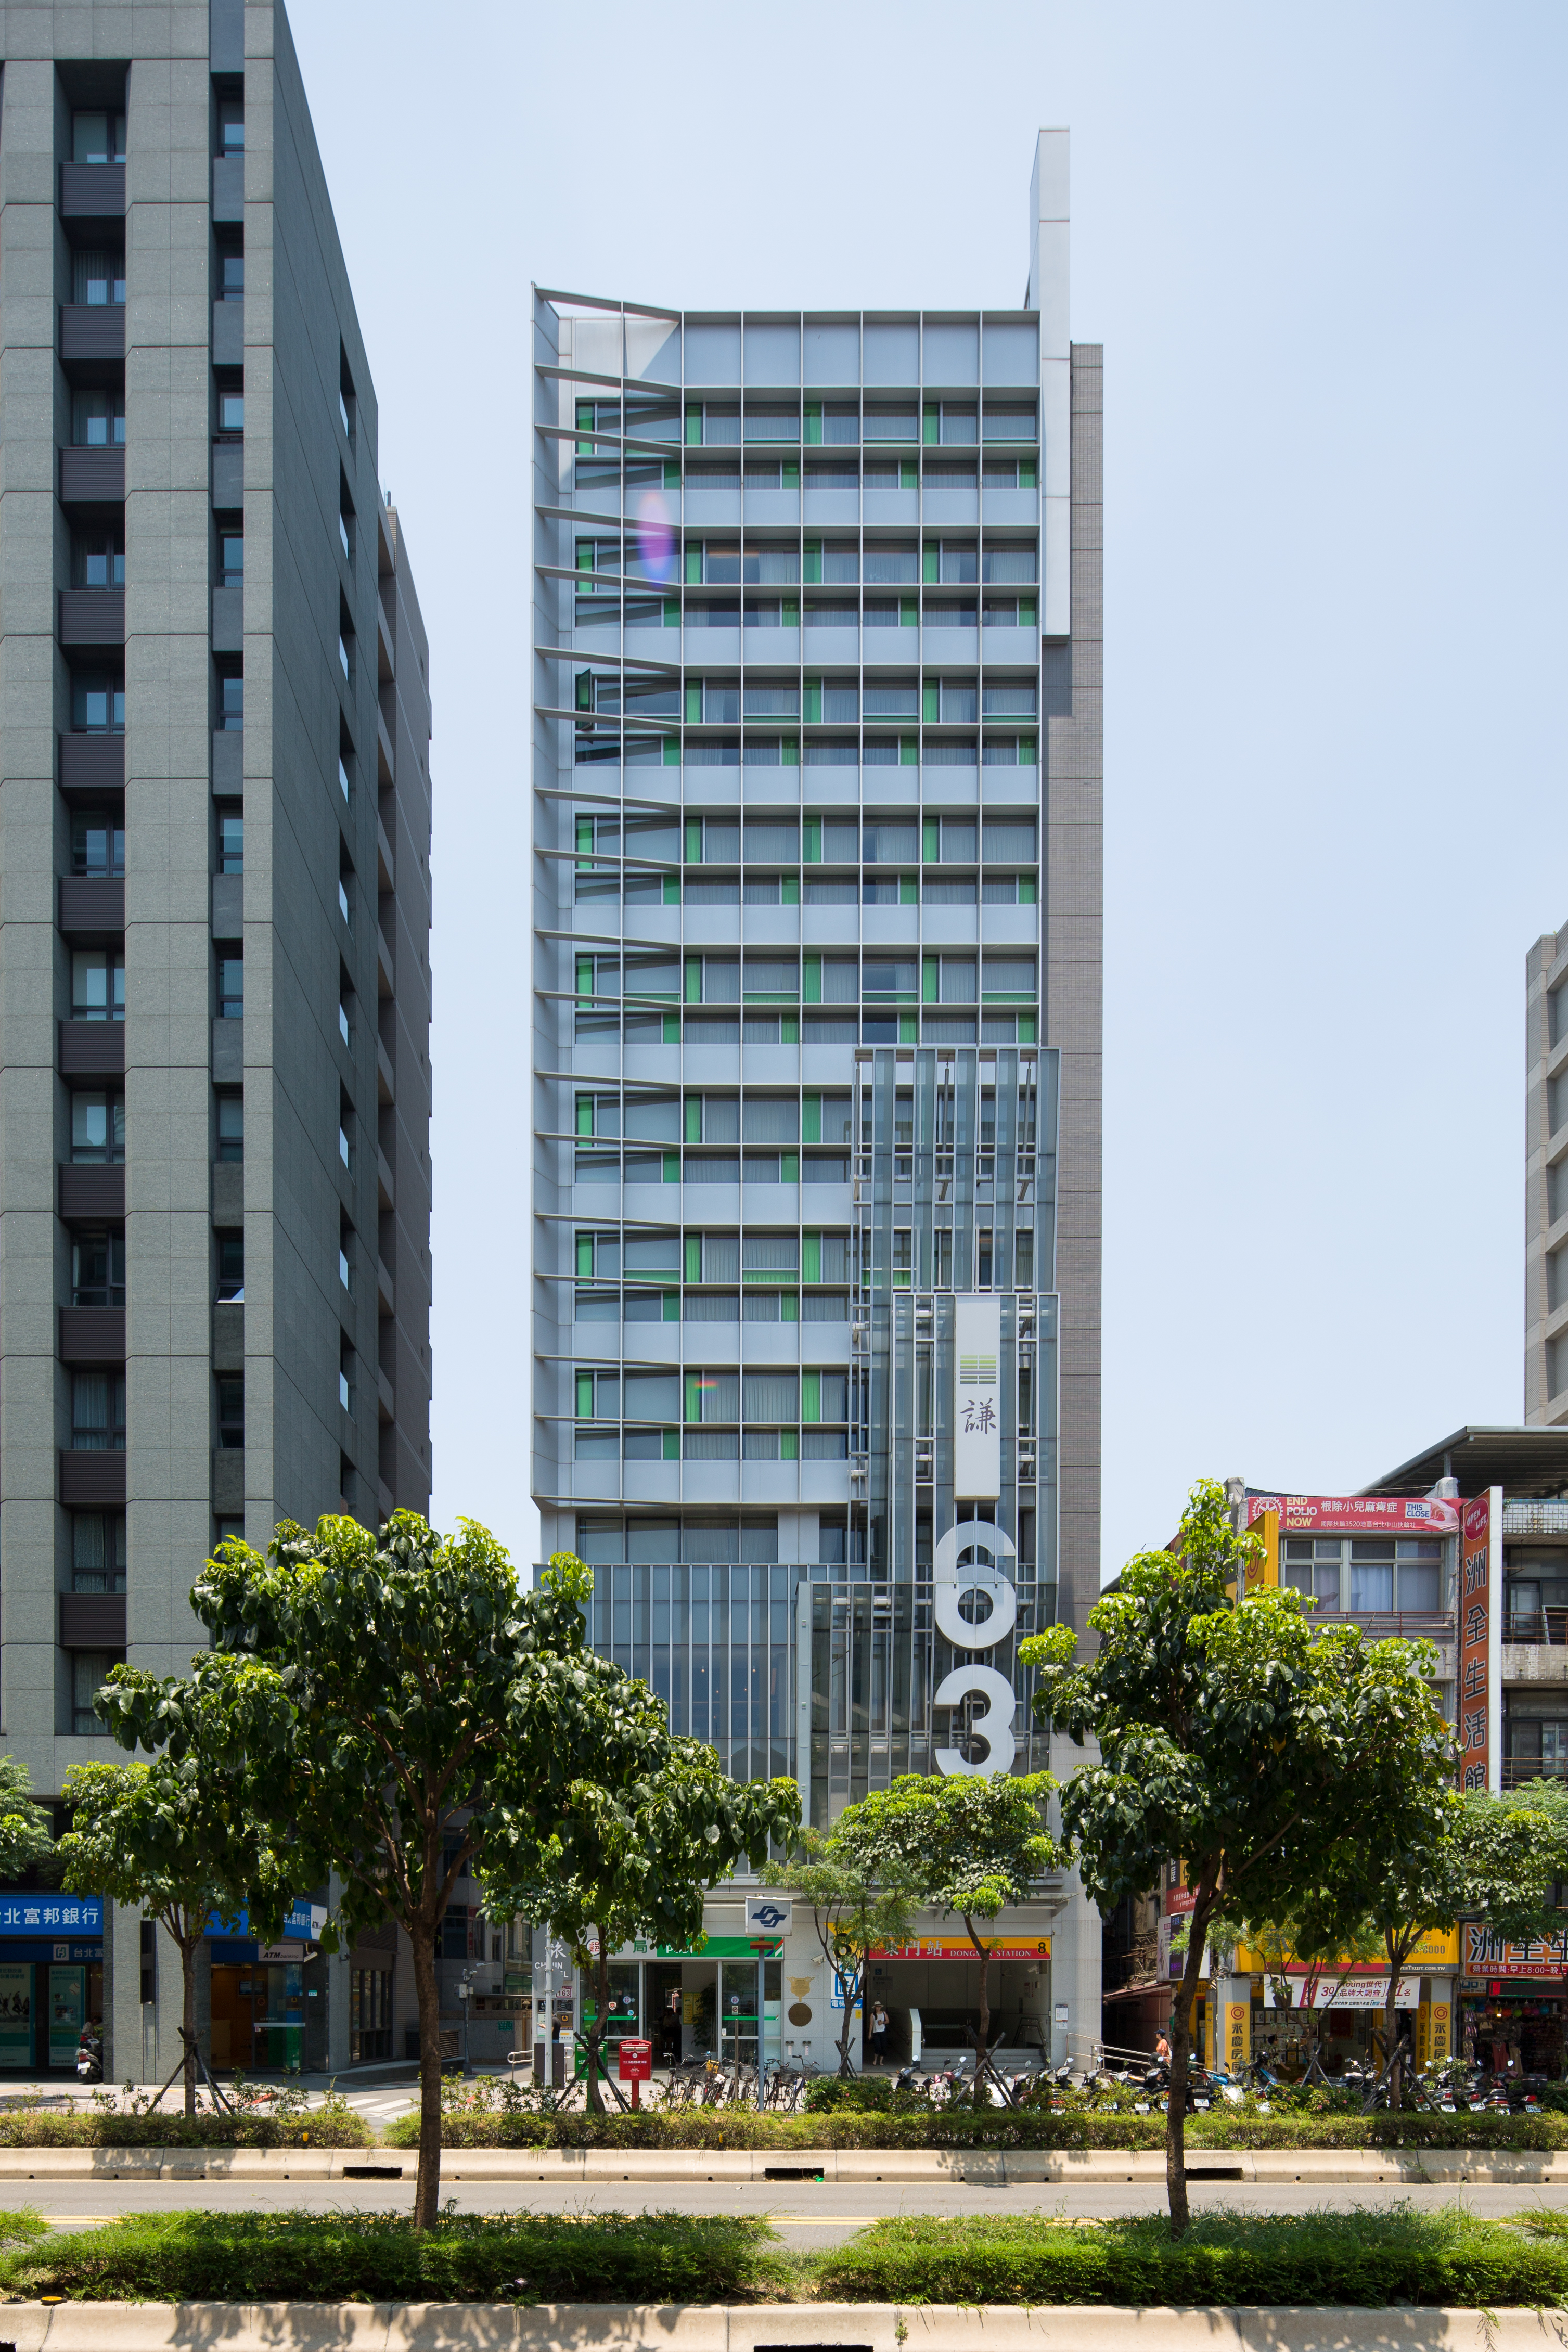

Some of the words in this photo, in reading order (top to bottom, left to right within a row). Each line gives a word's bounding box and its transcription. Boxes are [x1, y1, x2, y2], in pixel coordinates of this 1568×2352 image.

[960, 1398, 996, 1434] 謙
[1287, 1497, 1308, 1506] END
[1321, 1501, 1398, 1513] 根除小兒麻痺症
[1287, 1507, 1318, 1517] POLIO
[1467, 1508, 1481, 1526] OPEN
[1287, 1517, 1313, 1527] NOW
[1320, 1520, 1417, 1529] 國際扶輪3520地區台北中山扶輪社
[1475, 1513, 1487, 1531] LIFE
[1463, 1545, 1488, 1790] 洲全生活館
[1179, 1897, 1197, 1908] yungchin
[0, 1907, 99, 1924] 北富邦銀行
[1038, 1942, 1046, 1955] 8
[1339, 1989, 1381, 1997] 品牌大調查
[1231, 2023, 1243, 2072] 永慶房屋
[1434, 2023, 1446, 2060] 永慶房
